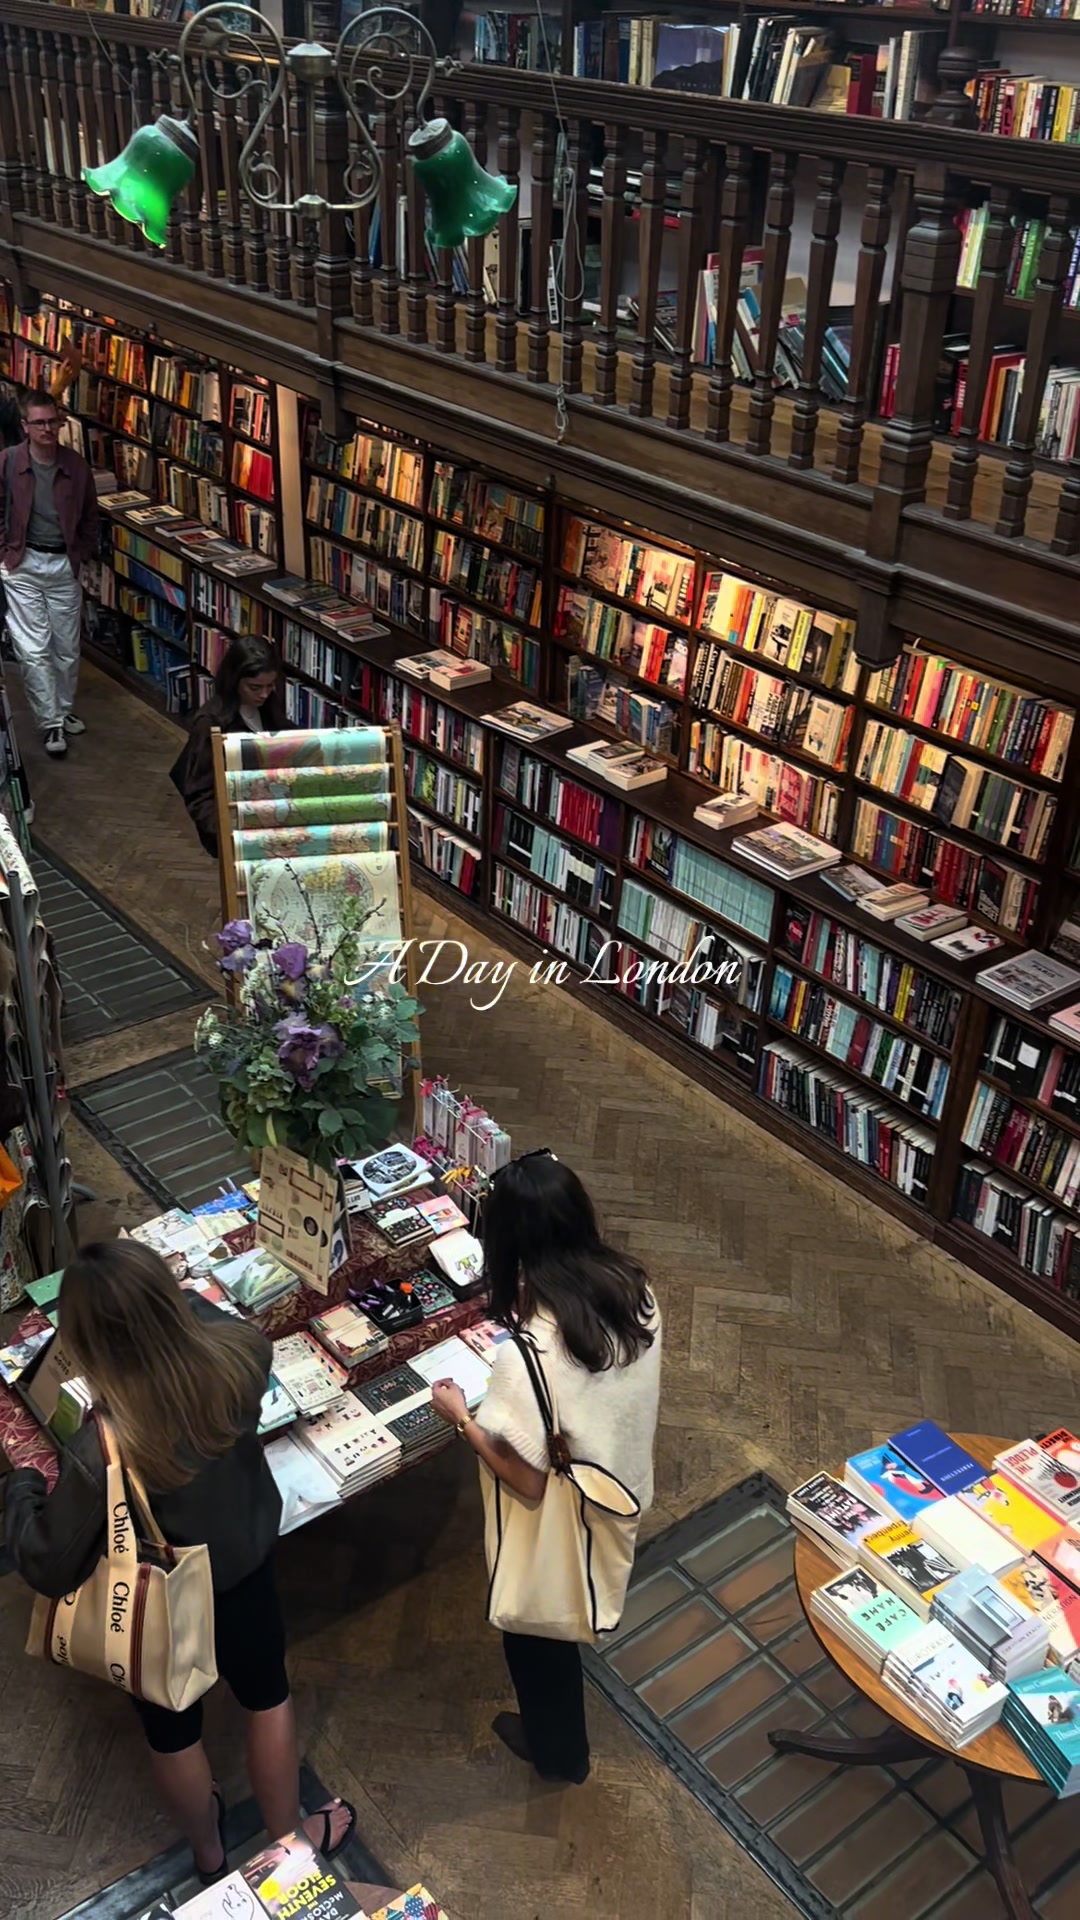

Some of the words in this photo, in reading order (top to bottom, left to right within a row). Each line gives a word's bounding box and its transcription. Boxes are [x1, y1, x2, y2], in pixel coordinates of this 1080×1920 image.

[794, 831, 821, 847] PARIS
[1004, 1446, 1039, 1467] PLEDGE
[940, 1462, 974, 1481] PERFECTION
[1015, 1463, 1034, 1475] THE
[113, 1501, 130, 1554] Chloé
[889, 1526, 915, 1544] Jenny
[110, 1581, 130, 1633] Chloé
[861, 1597, 895, 1621] NAME
[277, 1874, 336, 1920] SEVENTH
[279, 1869, 322, 1905] FLOOR
[300, 1891, 344, 1920] McCLOS
[306, 1900, 319, 1910] THE
